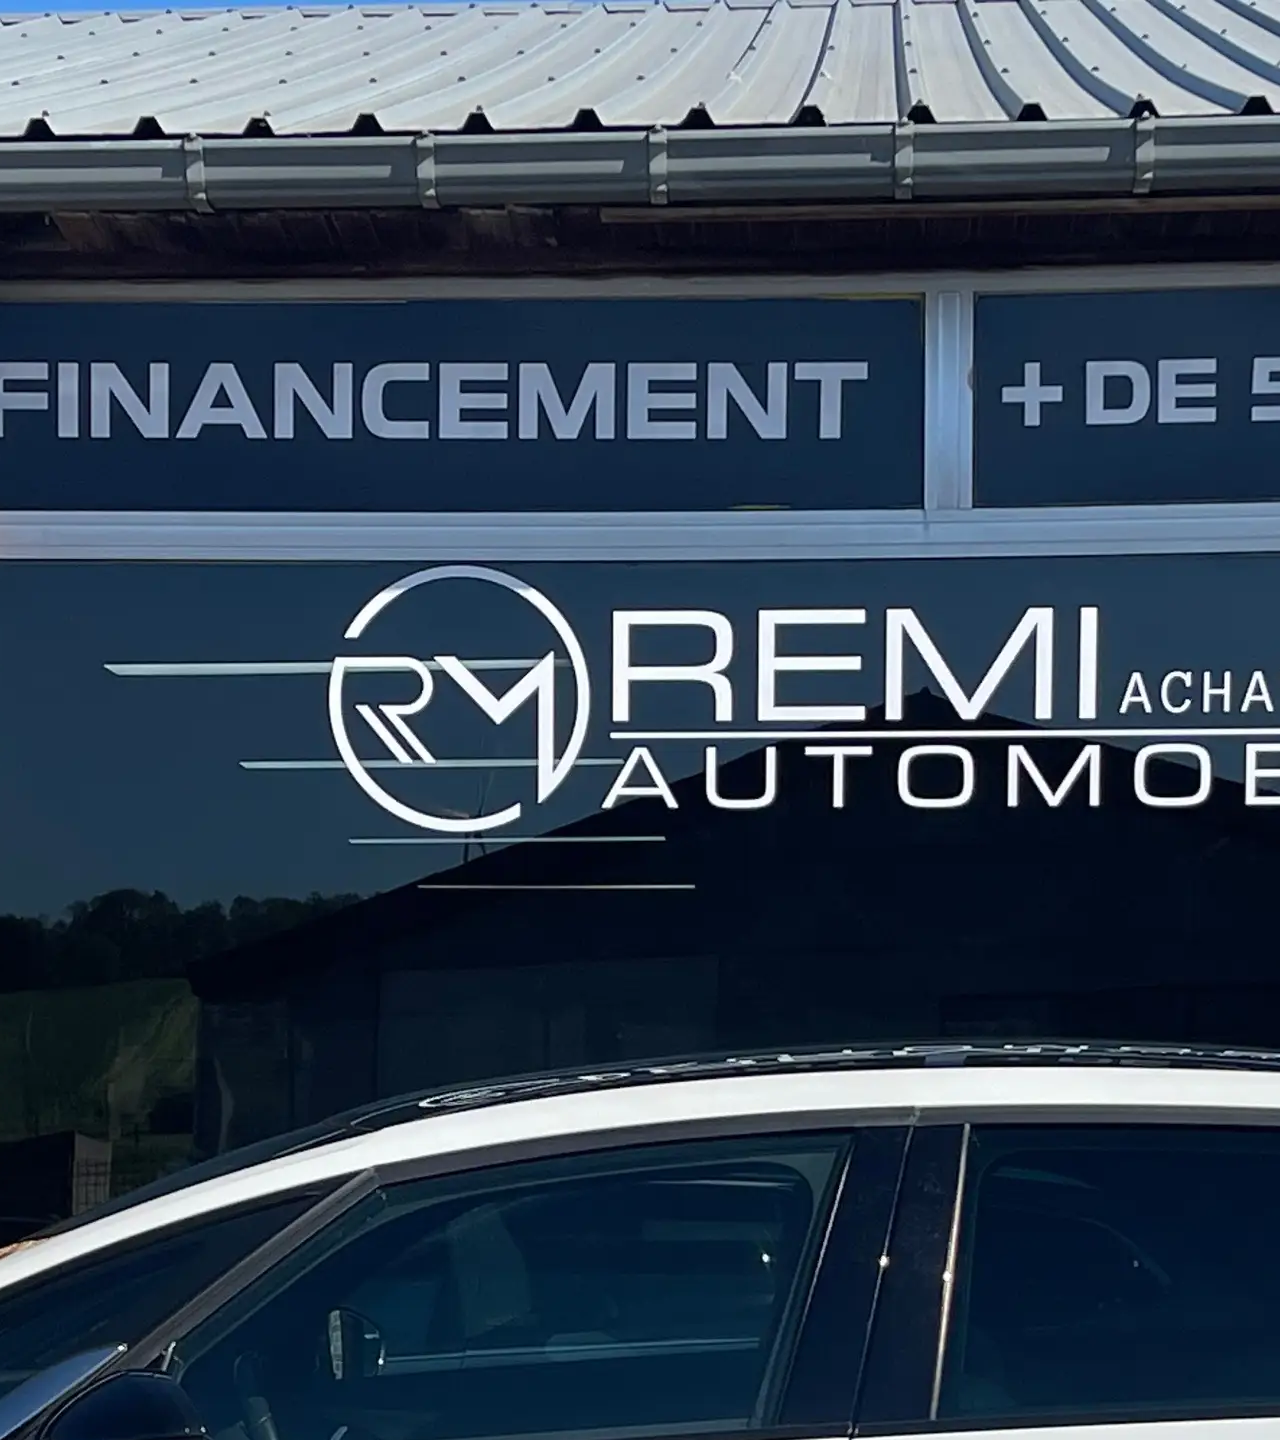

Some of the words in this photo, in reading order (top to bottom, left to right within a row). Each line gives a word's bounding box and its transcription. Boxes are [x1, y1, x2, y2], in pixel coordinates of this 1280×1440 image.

[1001, 362, 1063, 427] +
[1085, 358, 1218, 425] DE
[611, 607, 1099, 722] REMI
